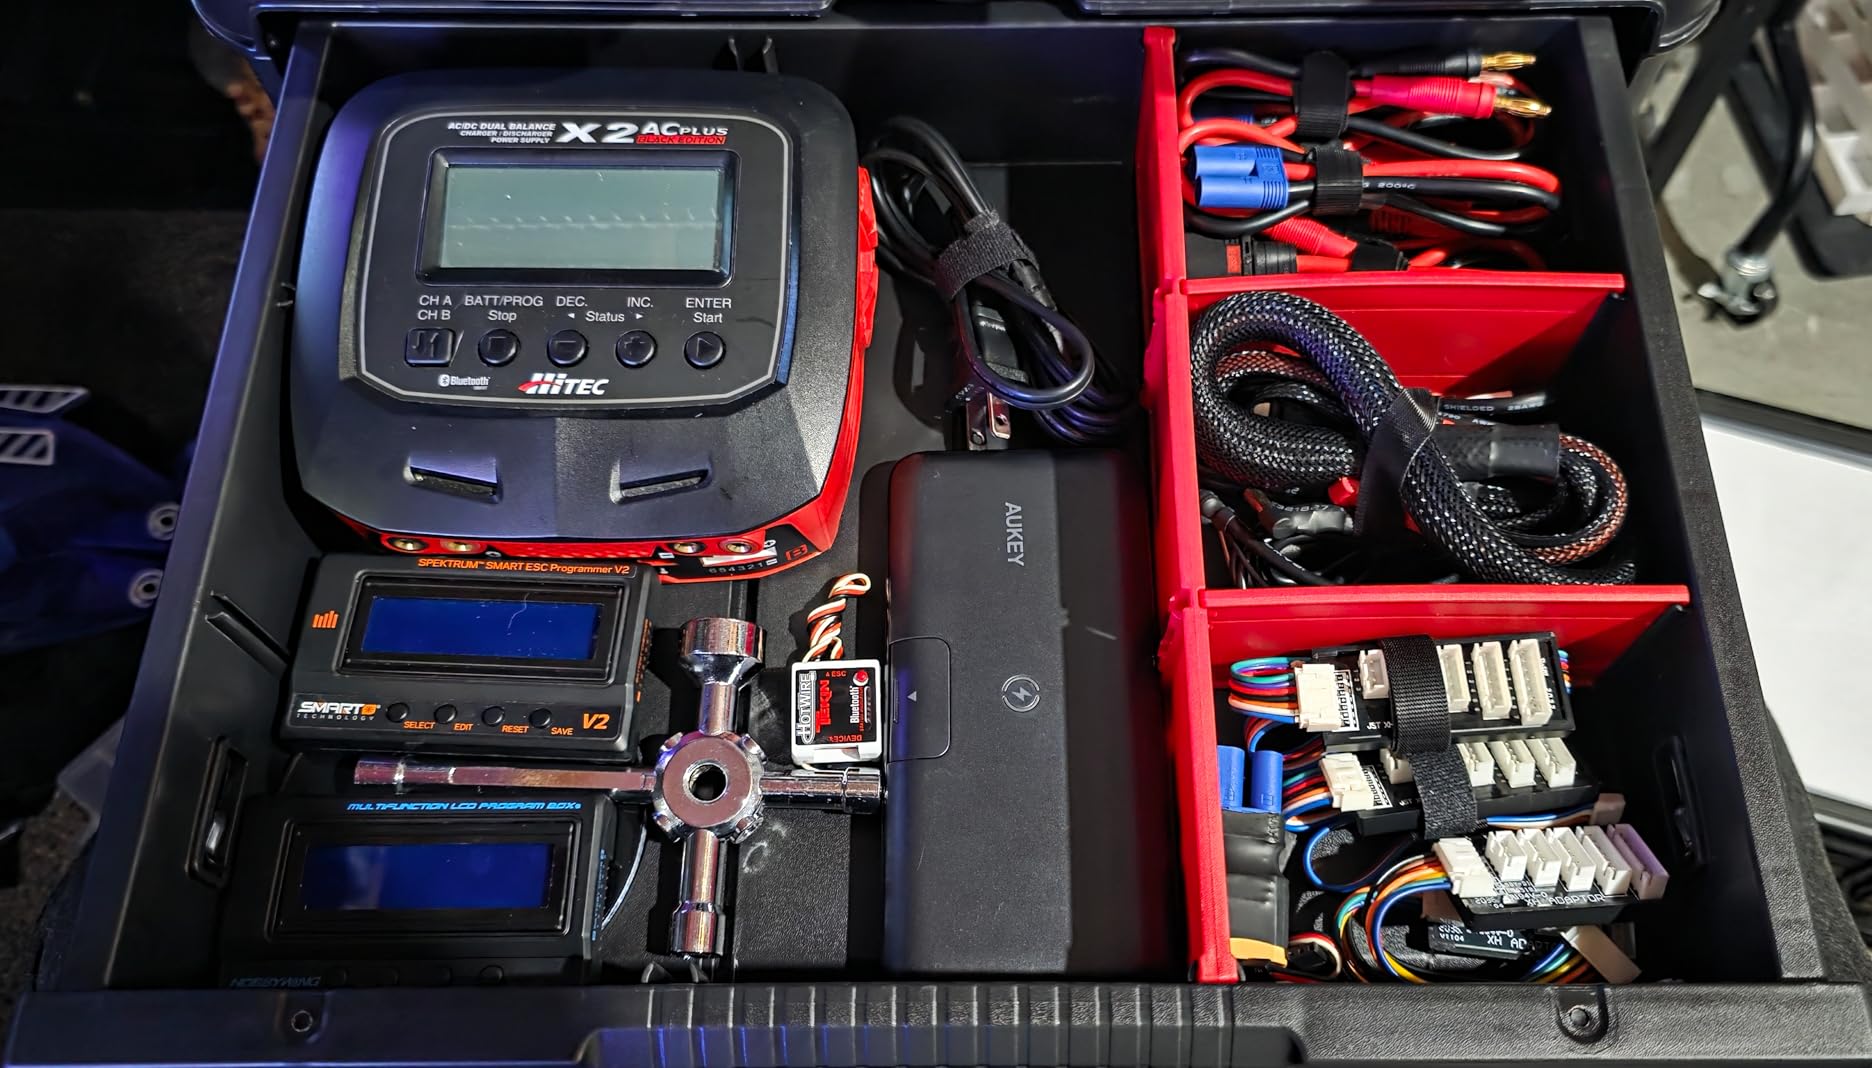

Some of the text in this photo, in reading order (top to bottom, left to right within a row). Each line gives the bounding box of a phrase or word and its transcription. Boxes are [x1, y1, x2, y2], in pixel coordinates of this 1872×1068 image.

[448, 122, 479, 130] AC/DC
[509, 123, 557, 131] BALANCE
[637, 136, 726, 145] BLACK EDITION
[419, 295, 452, 307] CH A
[464, 295, 544, 307] BATT/PROG
[556, 296, 589, 308] DEC.
[627, 296, 654, 308] INC.
[685, 297, 733, 310] ENTER
[417, 309, 451, 321] CH B
[488, 309, 517, 323] Stop
[585, 310, 625, 323] Status
[693, 311, 724, 324] Start
[1443, 403, 1495, 412] SHIELDED
[1004, 501, 1025, 567] AUKEY
[485, 561, 523, 571] SMART
[525, 563, 548, 572] ESC
[550, 564, 613, 575] Programmer
[614, 565, 630, 575] V2
[297, 700, 362, 715] SMART
[816, 679, 832, 734] TEKIN
[849, 686, 860, 724] Bluetooth
[296, 713, 375, 722] TECHNOLOGY
[582, 713, 610, 730] V2
[403, 720, 436, 730] SELECT
[453, 723, 474, 732] EDIT
[501, 724, 529, 734] RESET
[1366, 721, 1381, 730] JST
[551, 727, 575, 736] SAVE
[347, 802, 449, 811] MULTIFUNCTION
[450, 802, 477, 810] LCD
[478, 802, 545, 810] PROGRAM
[1549, 894, 1606, 906] ADAPTOR
[1486, 934, 1503, 946] XH
